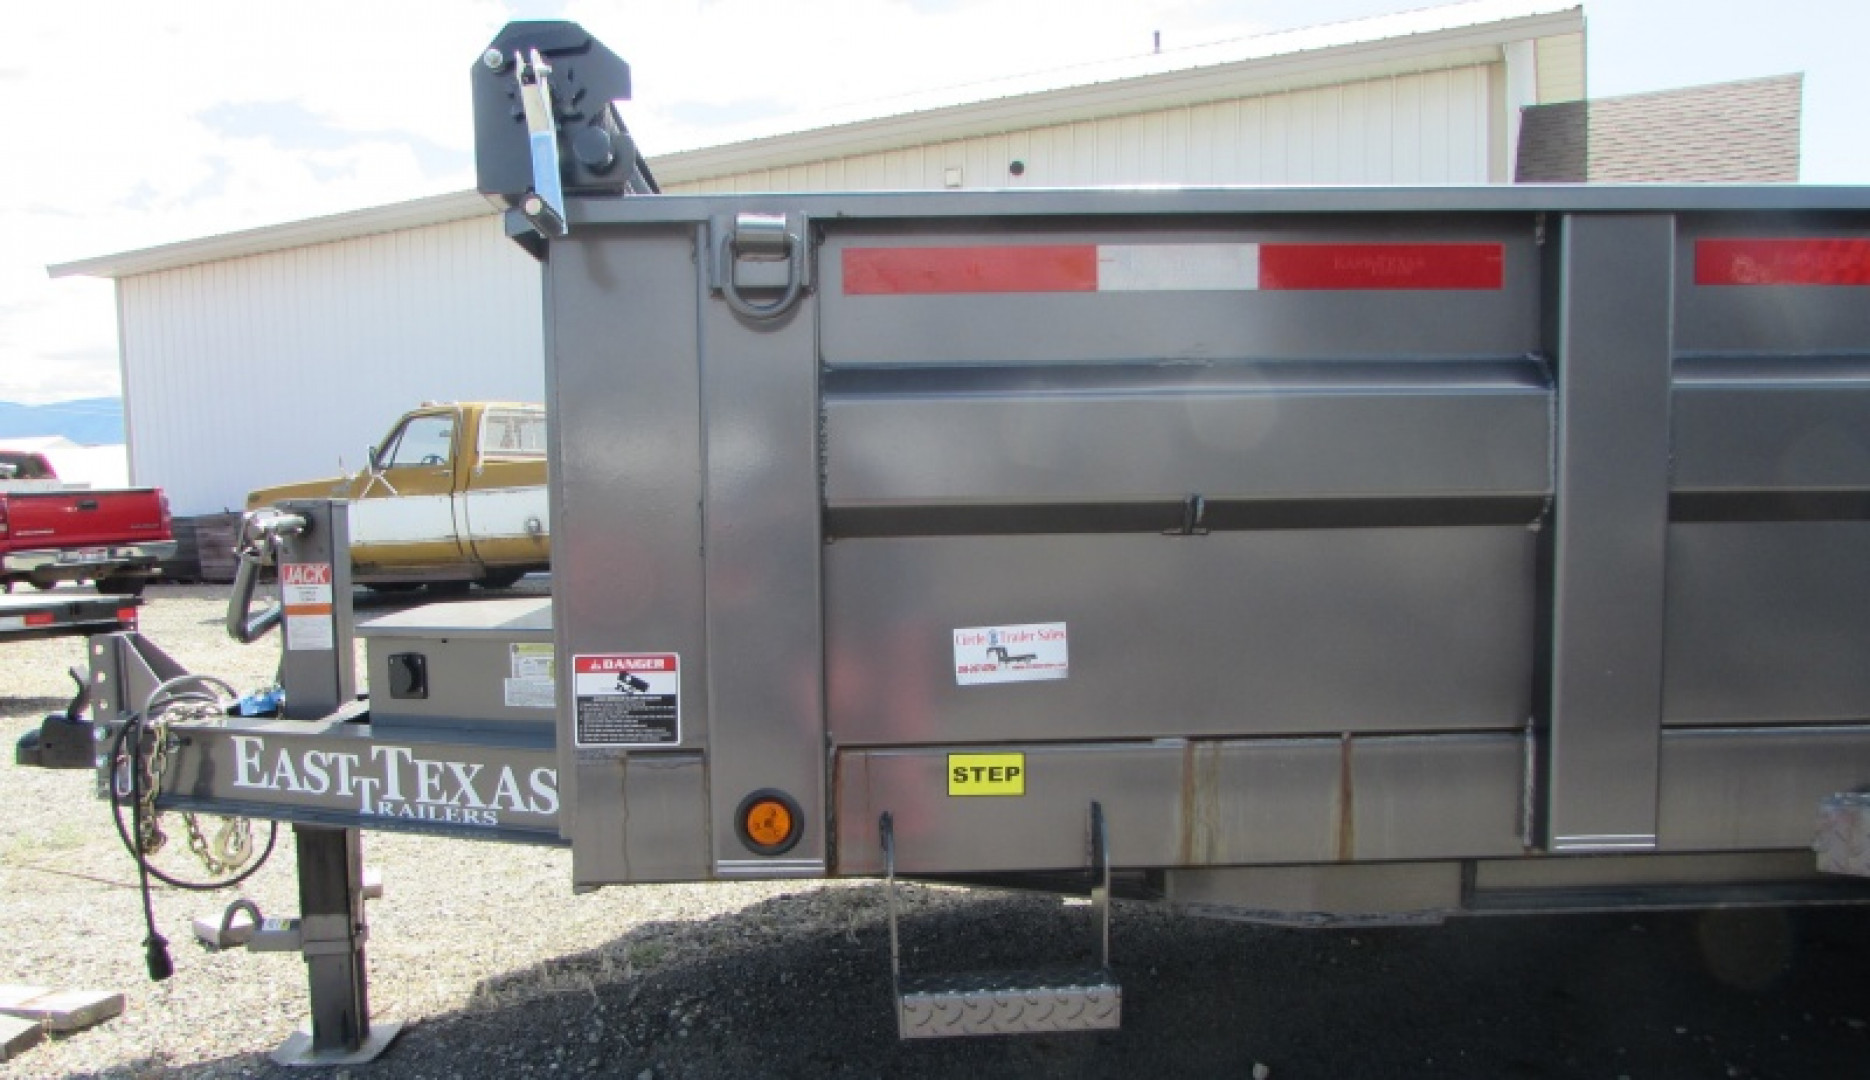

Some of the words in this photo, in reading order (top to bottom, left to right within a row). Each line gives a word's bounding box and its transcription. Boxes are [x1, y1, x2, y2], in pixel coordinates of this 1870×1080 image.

[288, 565, 327, 584] JACK
[1000, 630, 1035, 644] Trailer
[1037, 629, 1065, 641] Sales
[603, 658, 664, 670] DANGER
[231, 735, 359, 796] EAST
[371, 745, 560, 814] TEXAS
[953, 766, 1020, 783] STEP
[352, 776, 499, 826] TRAILERS
